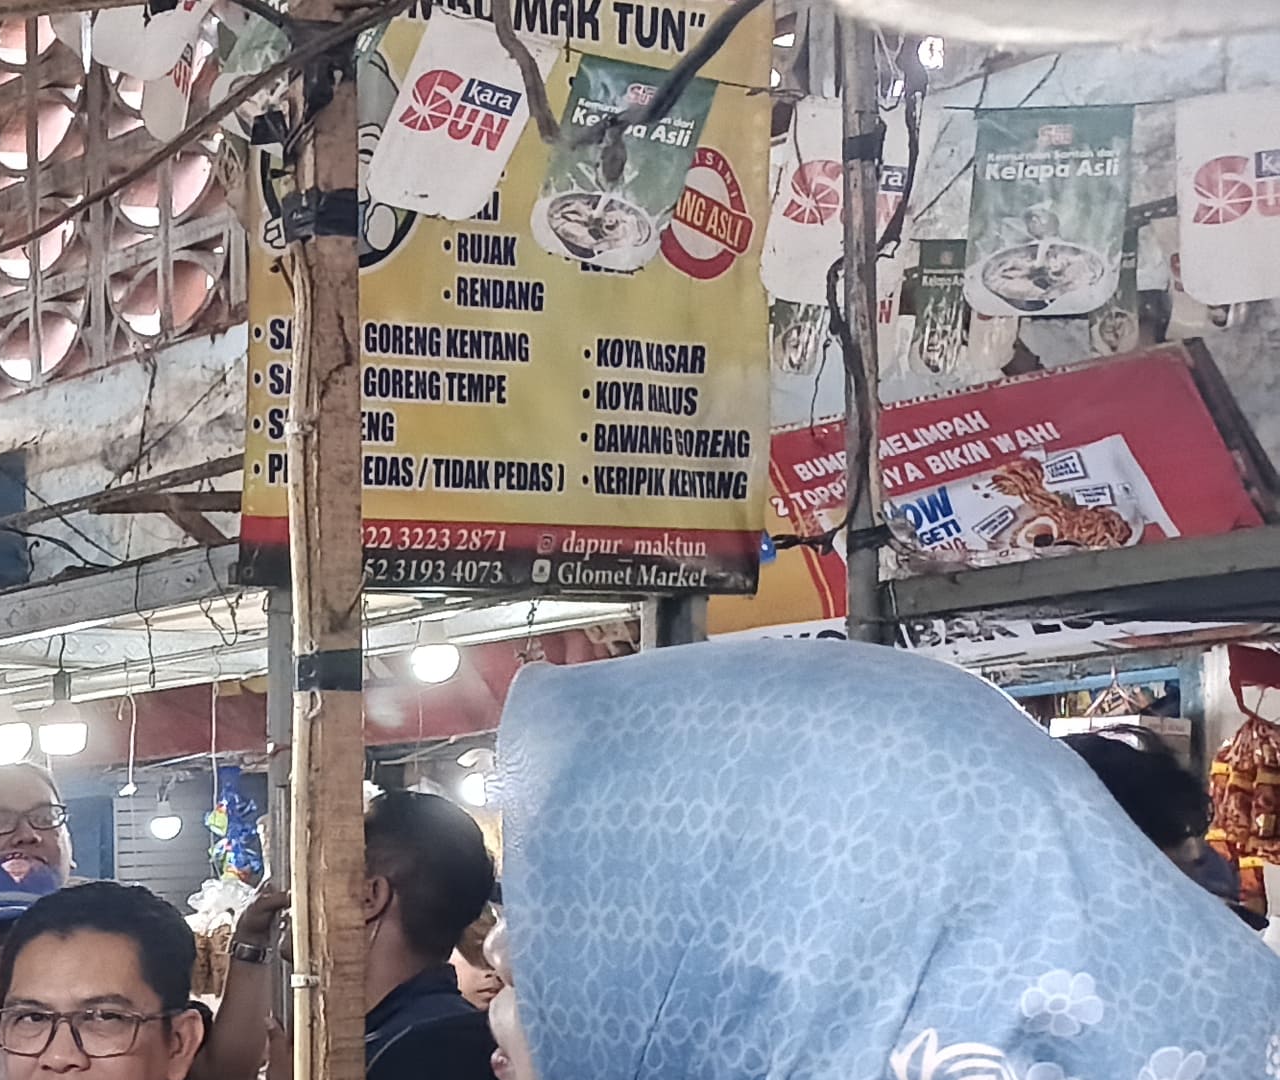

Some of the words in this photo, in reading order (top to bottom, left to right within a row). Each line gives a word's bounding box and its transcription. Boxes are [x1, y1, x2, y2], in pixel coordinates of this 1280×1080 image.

[467, 77, 514, 111] kara
[650, 125, 692, 148] Asli
[985, 160, 1071, 183] Kelapa
[1076, 157, 1120, 178] Asli
[706, 205, 744, 248] ASLI
[456, 232, 517, 267] RUJAK
[455, 276, 545, 312] RENDANG
[364, 321, 441, 358] GORENG
[446, 327, 530, 363] KENTANG
[596, 338, 641, 369] KOYA
[646, 342, 707, 374] KASAR
[363, 366, 441, 401] GORENG
[445, 371, 507, 404] TEMPE
[595, 380, 644, 412] KOYA
[648, 383, 699, 416] HALUS
[593, 423, 673, 455] BAWANG
[674, 428, 751, 459] GORENG
[878, 409, 990, 461] MELIMPAH
[363, 455, 414, 487] EDAS
[431, 458, 490, 489] TIDAK
[494, 461, 553, 492] PEDAS
[593, 465, 666, 497] KERIPIK
[668, 467, 749, 500] KENTANG
[771, 496, 789, 518] 2
[925, 440, 991, 474] BIKIN
[396, 526, 451, 551] 3223
[456, 529, 507, 552] 2871
[920, 519, 962, 547] GETI
[364, 559, 387, 583] 52
[391, 559, 446, 583] 3193
[450, 559, 504, 584] 4073
[556, 560, 632, 587] Glomet
[635, 563, 707, 588] Market
